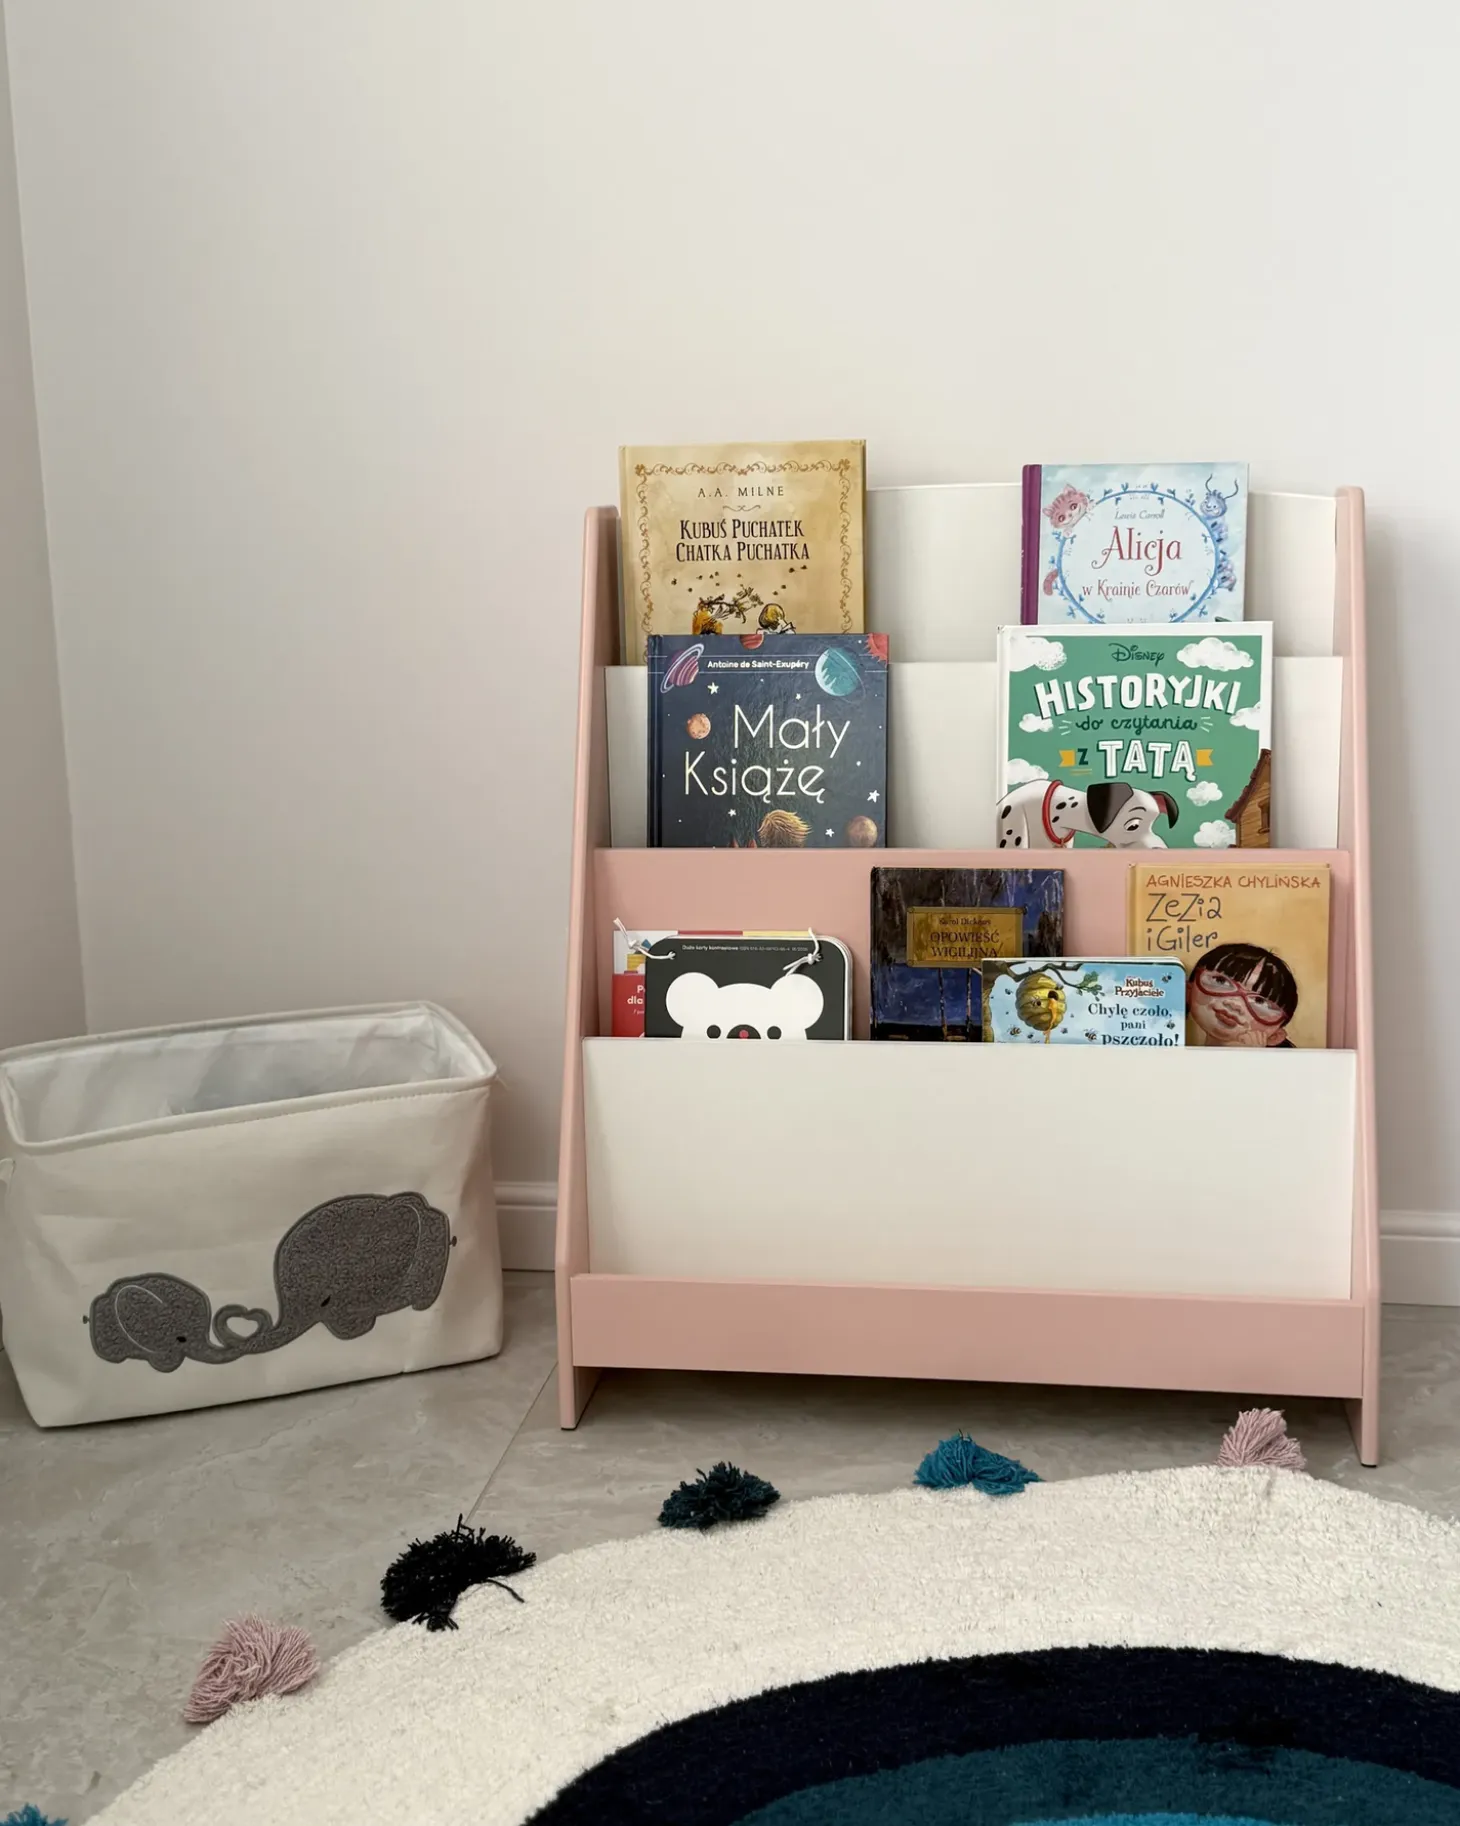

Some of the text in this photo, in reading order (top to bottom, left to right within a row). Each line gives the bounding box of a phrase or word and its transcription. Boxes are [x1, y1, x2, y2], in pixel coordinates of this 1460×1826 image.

[698, 486, 785, 498] A.A. MILNE
[680, 518, 805, 540] KUBUŚ PUCHATEK
[676, 542, 810, 562] CHATKA PUCHATKA
[1091, 525, 1183, 577] Alicja
[1082, 578, 1195, 602] w Krainie Czarów
[707, 660, 810, 670] Antoine de Saint-Exupéry
[1034, 672, 1242, 720] HISTORYJKI
[734, 704, 851, 758] Mały
[1075, 715, 1199, 735] do czytania
[1097, 738, 1198, 782] TATĄ
[685, 751, 826, 804] Książę
[1145, 874, 1233, 889] AGNIESZKA
[930, 929, 1000, 944] OPOWIEŚĆ
[1147, 925, 1219, 953] i Giler
[931, 946, 998, 959] WIGILIJNA
[1114, 986, 1165, 998] Przyjaciele
[1088, 1003, 1128, 1018] Chylę
[1120, 1020, 1147, 1031] pani
